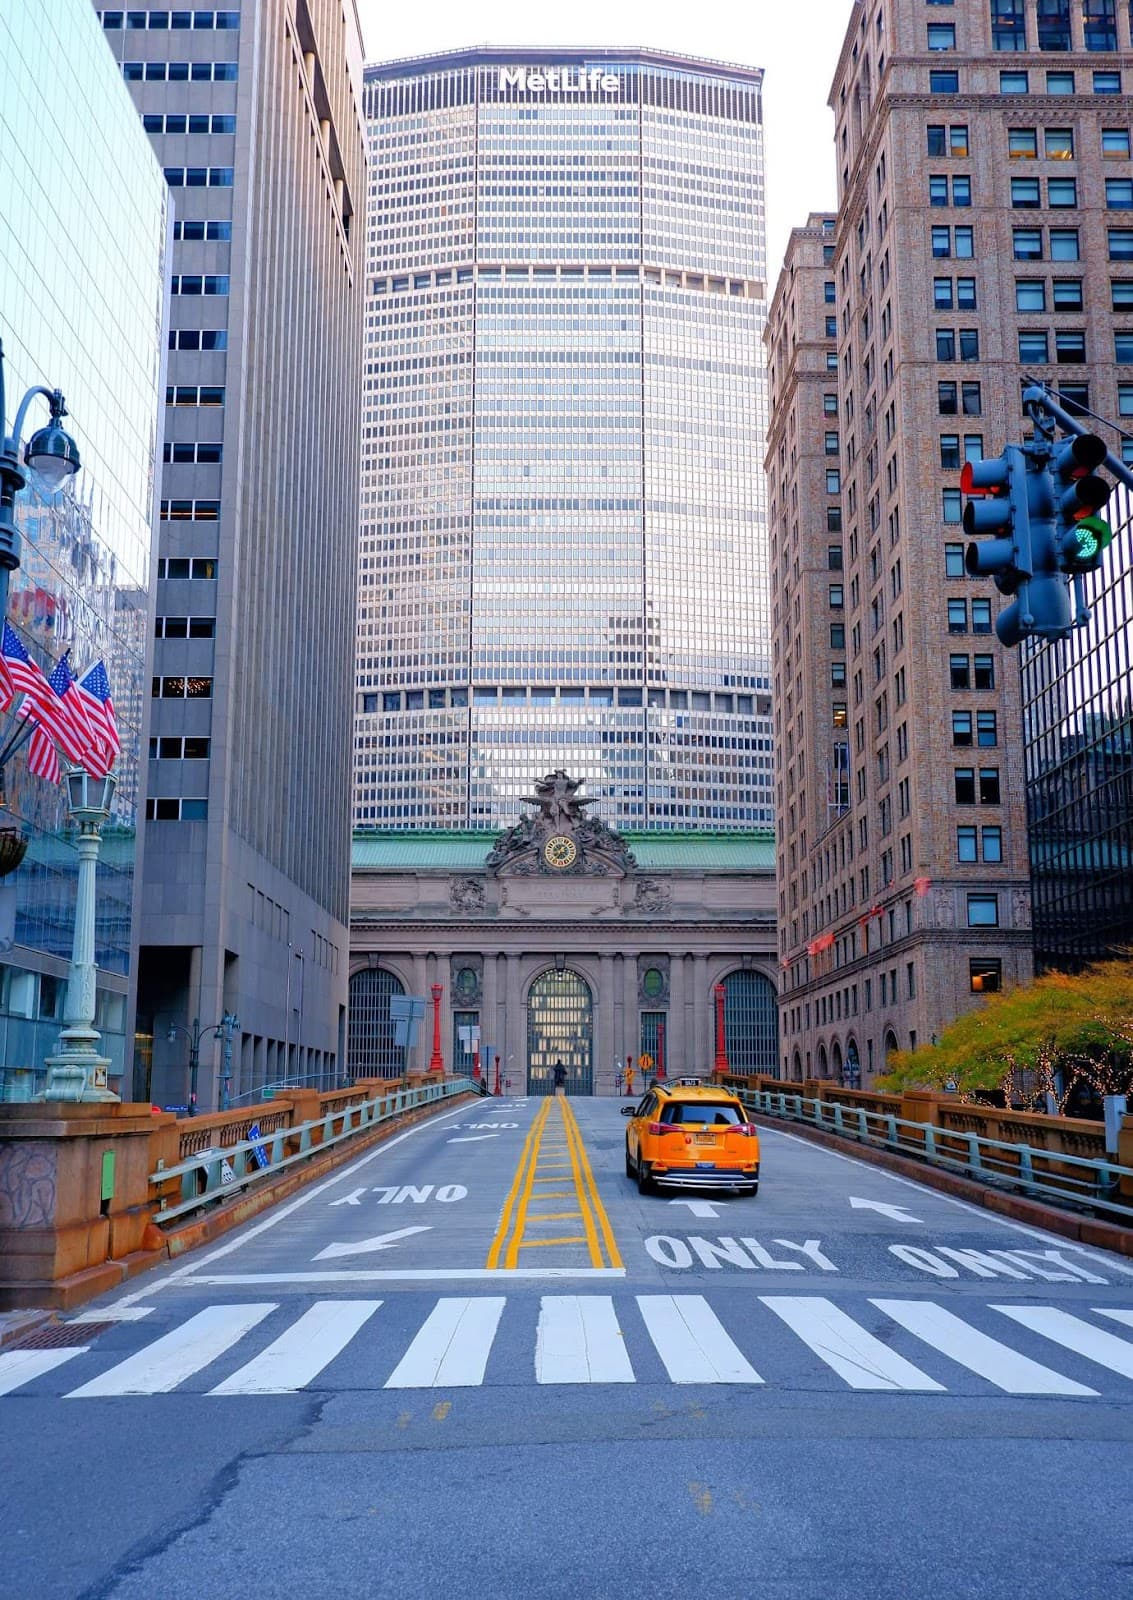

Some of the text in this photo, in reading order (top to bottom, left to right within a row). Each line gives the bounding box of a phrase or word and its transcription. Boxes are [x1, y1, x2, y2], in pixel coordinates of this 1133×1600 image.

[499, 67, 619, 92] MetLife
[441, 1122, 520, 1130] ONLY
[328, 1184, 468, 1206] ONLY
[643, 1239, 840, 1271] ONLY
[887, 1244, 1109, 1285] ONLY
